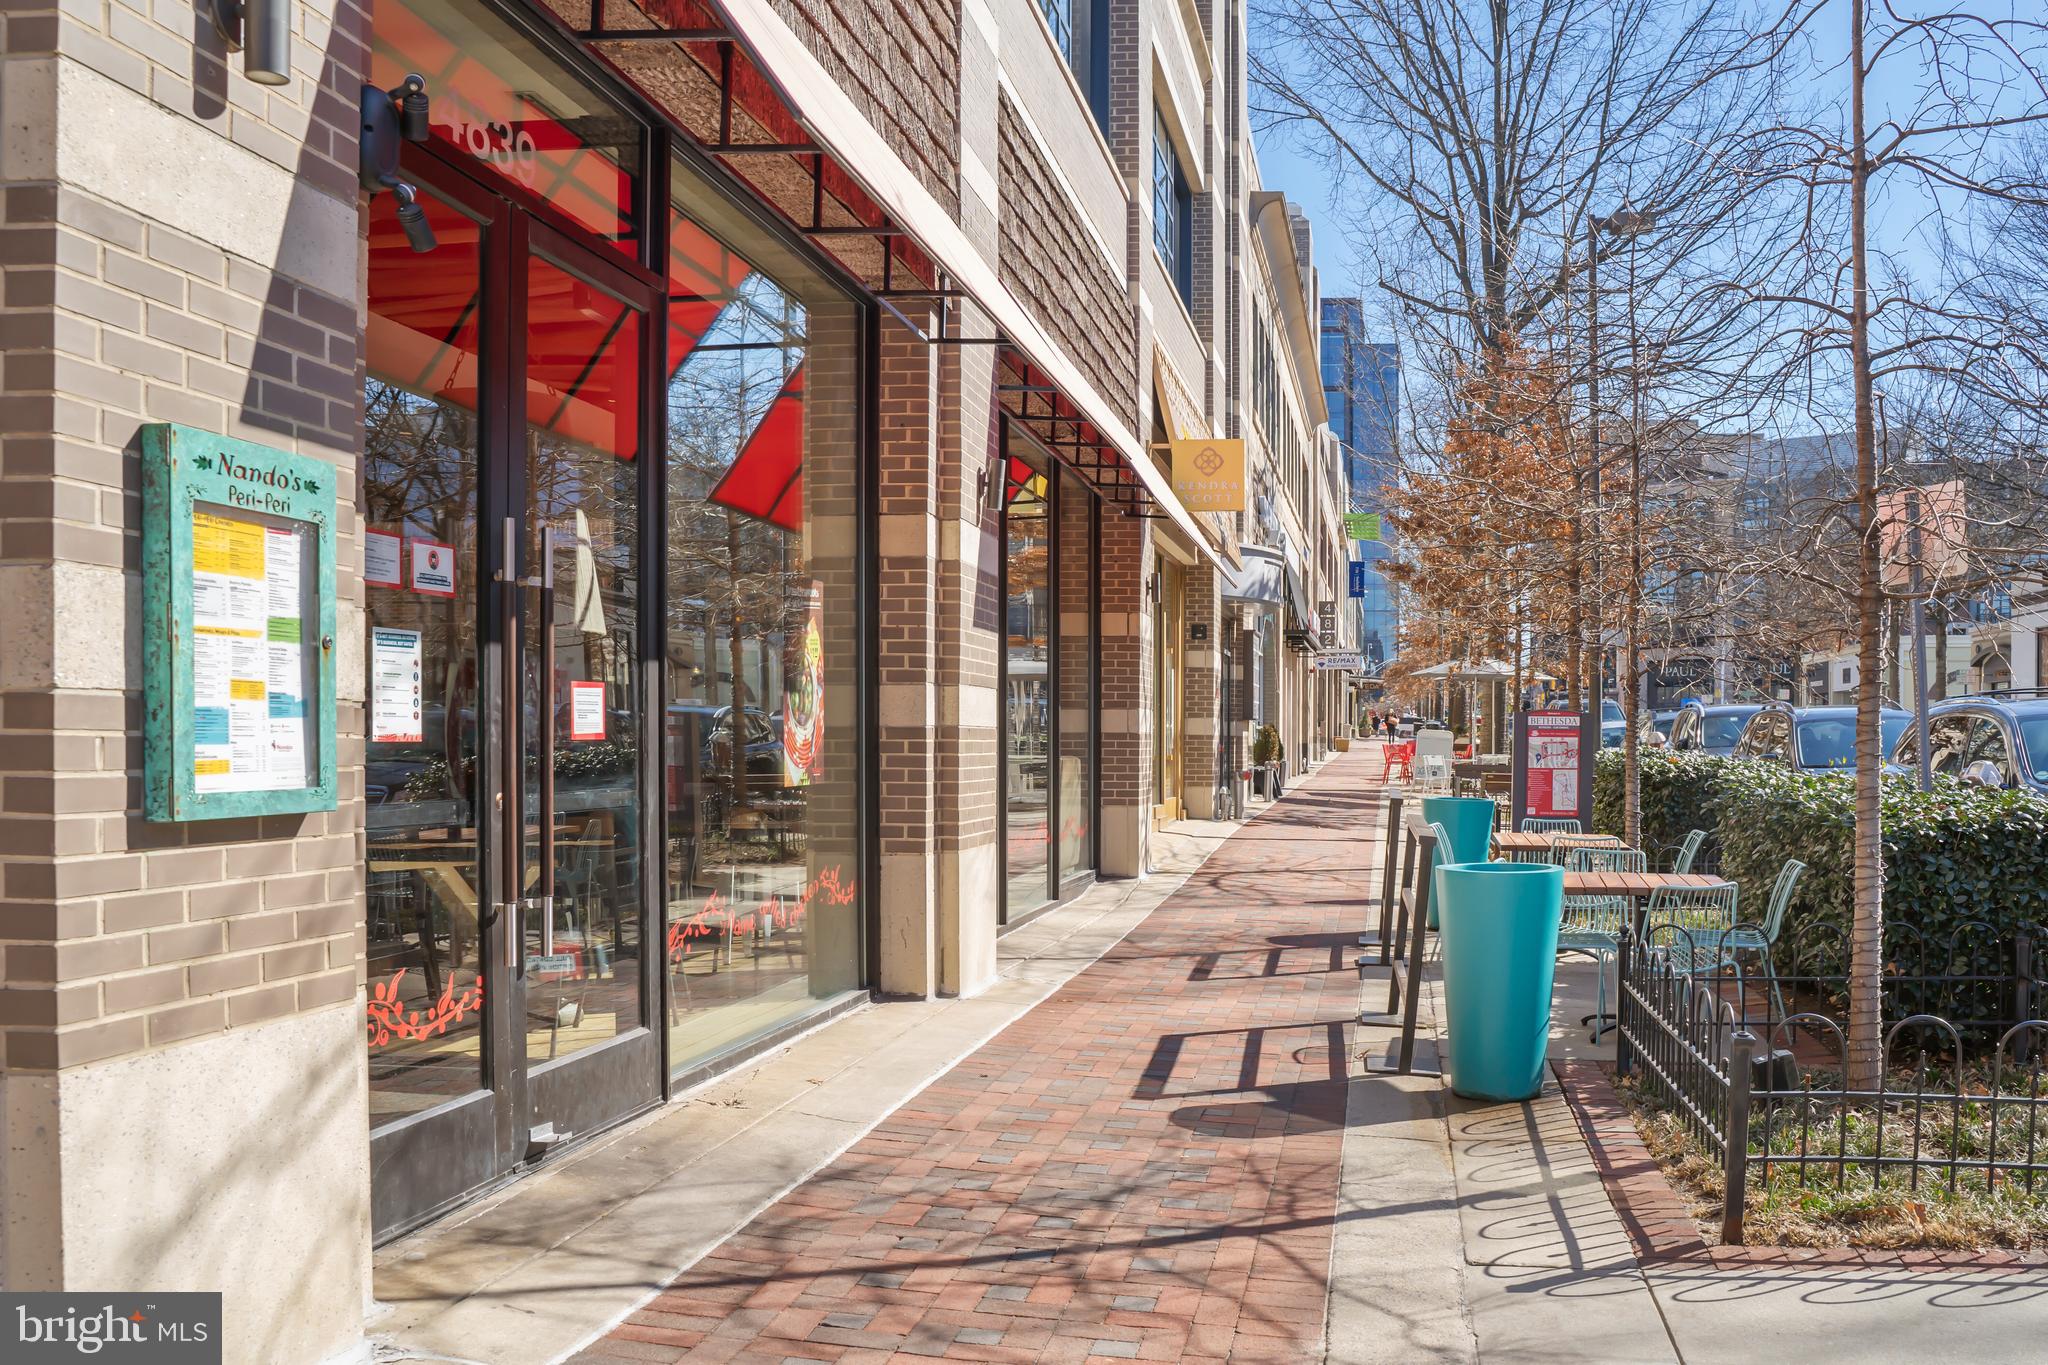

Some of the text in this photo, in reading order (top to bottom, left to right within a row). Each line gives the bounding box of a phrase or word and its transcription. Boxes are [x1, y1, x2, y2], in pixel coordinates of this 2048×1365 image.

[217, 452, 302, 492] Nando's
[1178, 480, 1240, 491] KENDRA
[228, 485, 291, 513] Peri-Peri
[1184, 493, 1233, 504] SCOTT
[1665, 665, 1697, 677] PAUL
[1530, 717, 1578, 725] BETHESDA
